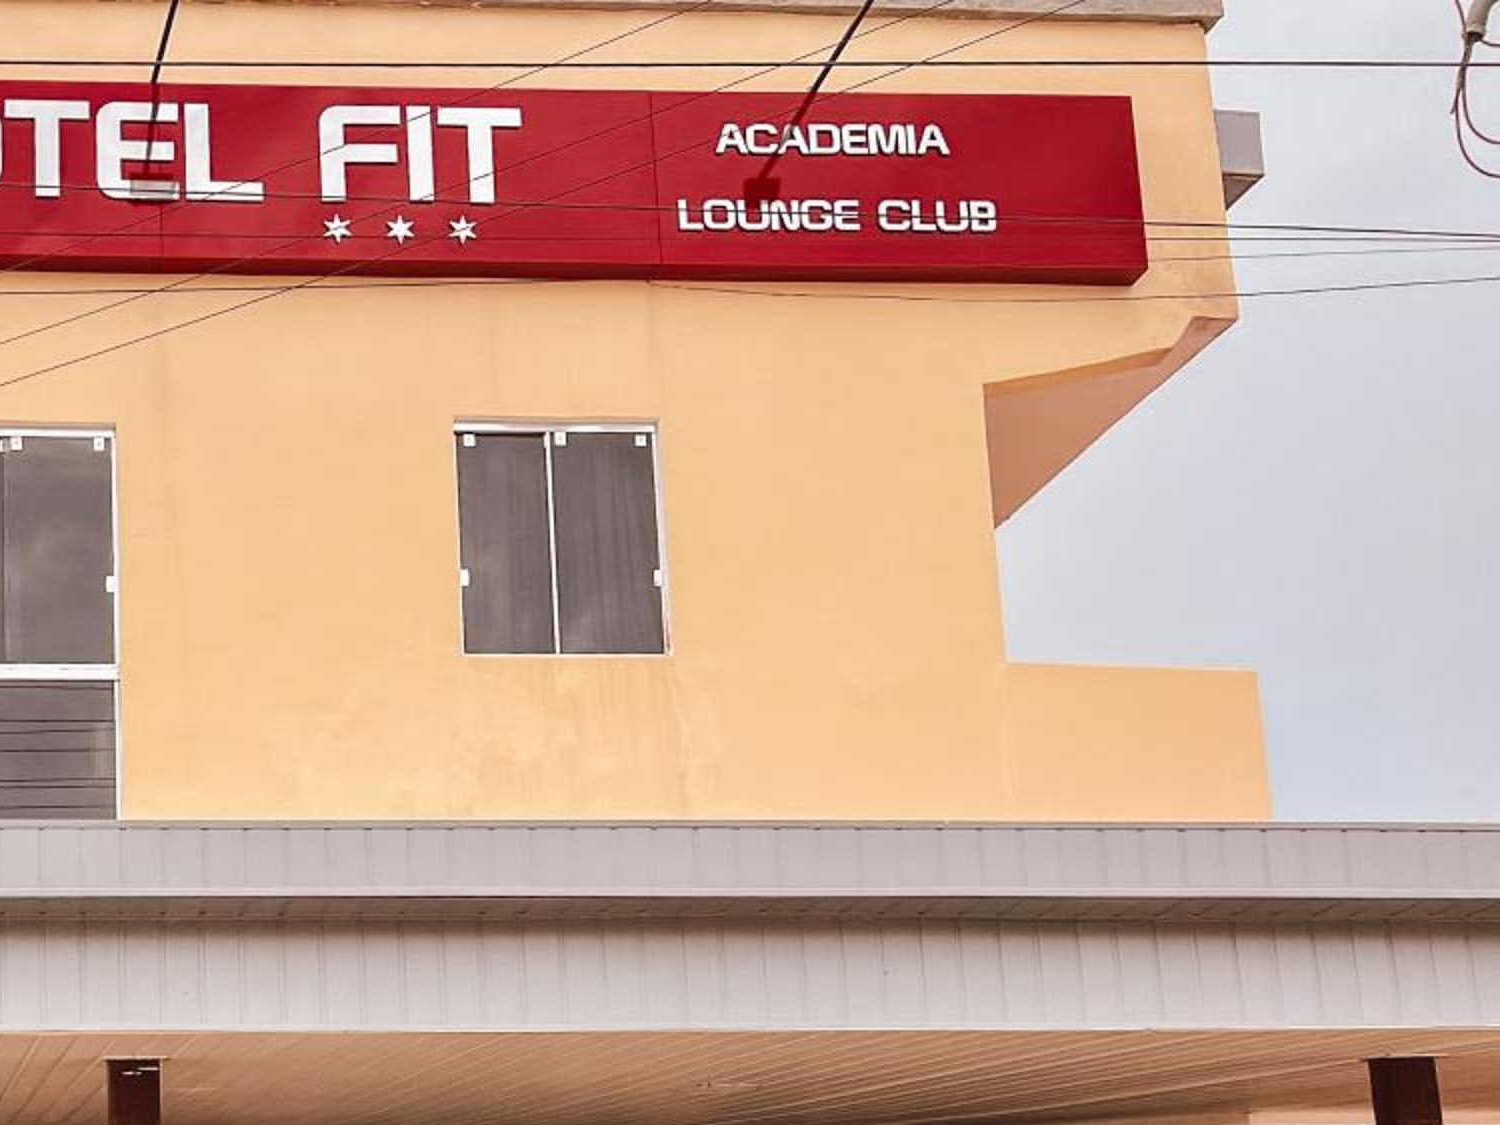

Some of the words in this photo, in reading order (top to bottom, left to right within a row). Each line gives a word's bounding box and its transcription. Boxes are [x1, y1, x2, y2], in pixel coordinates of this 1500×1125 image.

[318, 105, 524, 206] FIT
[715, 122, 951, 157] ACADEMIA
[676, 198, 861, 232] LOUNGE
[877, 200, 997, 233] CLUB
